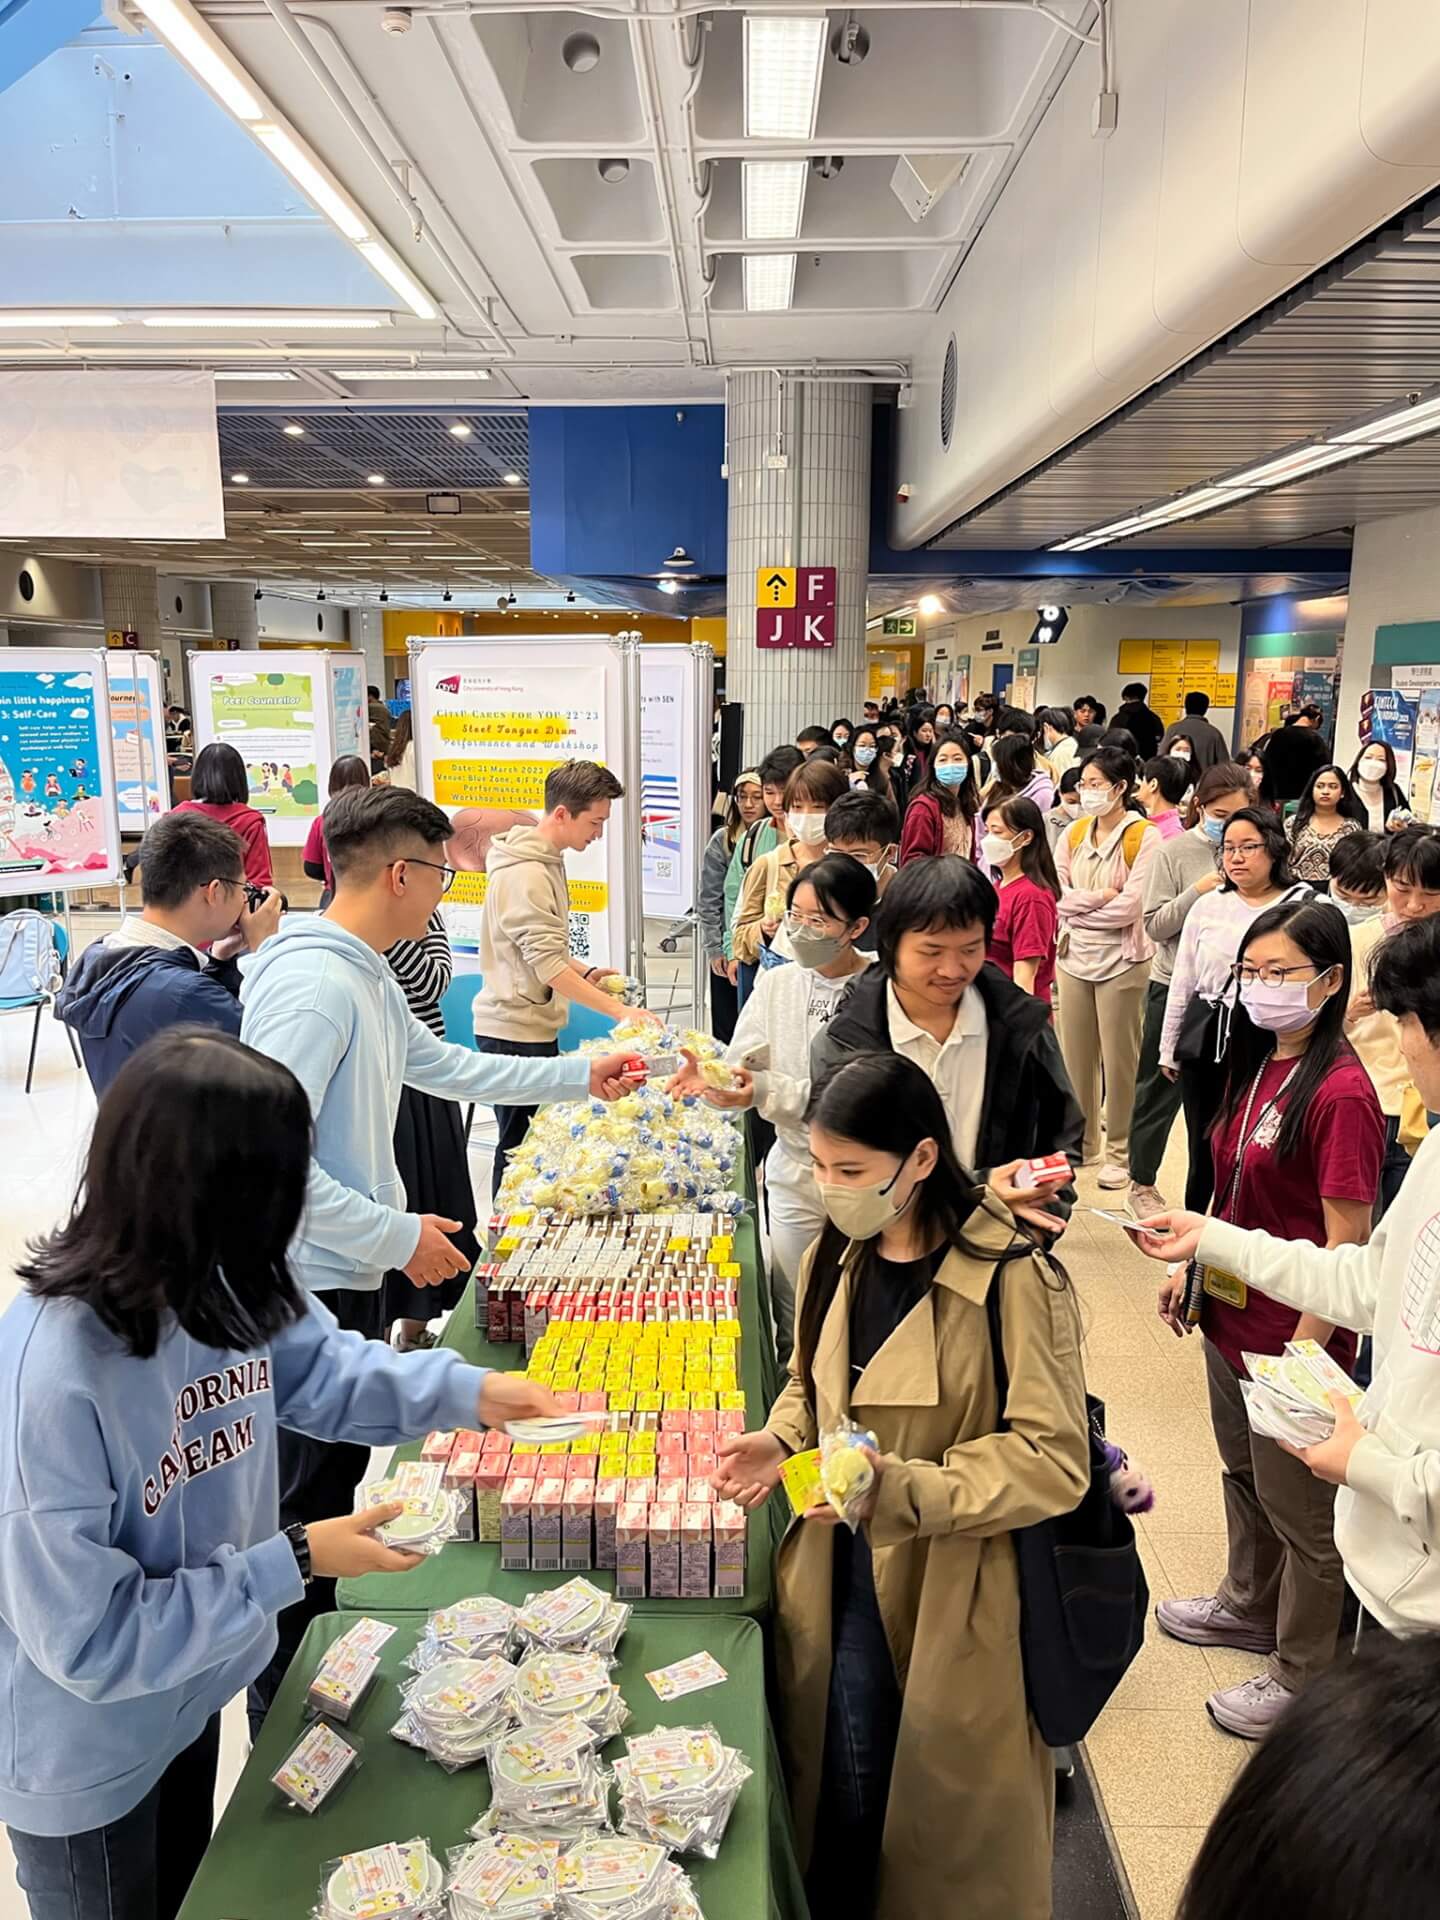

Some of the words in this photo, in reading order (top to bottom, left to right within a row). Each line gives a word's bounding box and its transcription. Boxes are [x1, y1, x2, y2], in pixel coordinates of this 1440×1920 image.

[808, 574, 824, 601] F
[769, 615, 782, 642] J
[804, 615, 825, 641] K
[126, 636, 134, 645] C
[14, 695, 37, 705] little
[39, 695, 91, 707] happiness?
[110, 695, 137, 703] ourney
[223, 696, 244, 705] Peer
[247, 696, 301, 705] Counsellor
[662, 695, 674, 704] SEN
[12, 709, 57, 719] Self-Care
[462, 723, 491, 733] Steel
[497, 724, 539, 737] Tongue
[545, 725, 577, 735] Drum
[443, 738, 511, 750] Performance
[516, 740, 536, 748] and
[543, 739, 599, 752] Workshop
[452, 763, 476, 772] Date:
[490, 765, 518, 774] March
[436, 773, 466, 781] Venue:
[468, 774, 486, 782] Blue
[463, 784, 520, 794] Performance
[524, 787, 533, 795] at
[451, 793, 494, 803] Workshop
[181, 1412, 256, 1485] EAM
